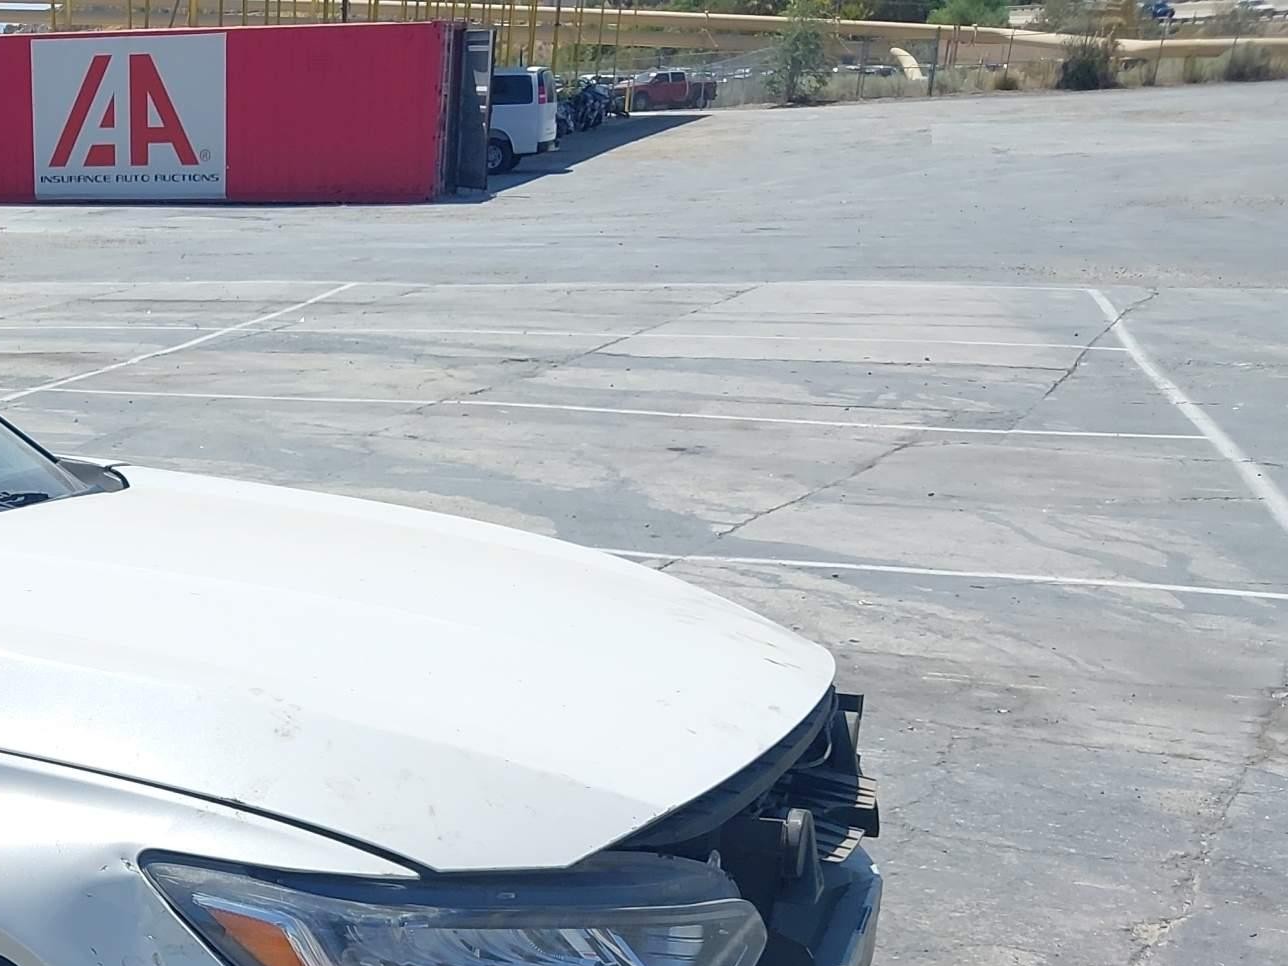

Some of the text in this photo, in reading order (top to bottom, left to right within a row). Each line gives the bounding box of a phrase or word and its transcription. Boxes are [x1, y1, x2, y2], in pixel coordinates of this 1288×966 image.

[40, 173, 220, 183] INSURANCE AUTO AUCTIONS
